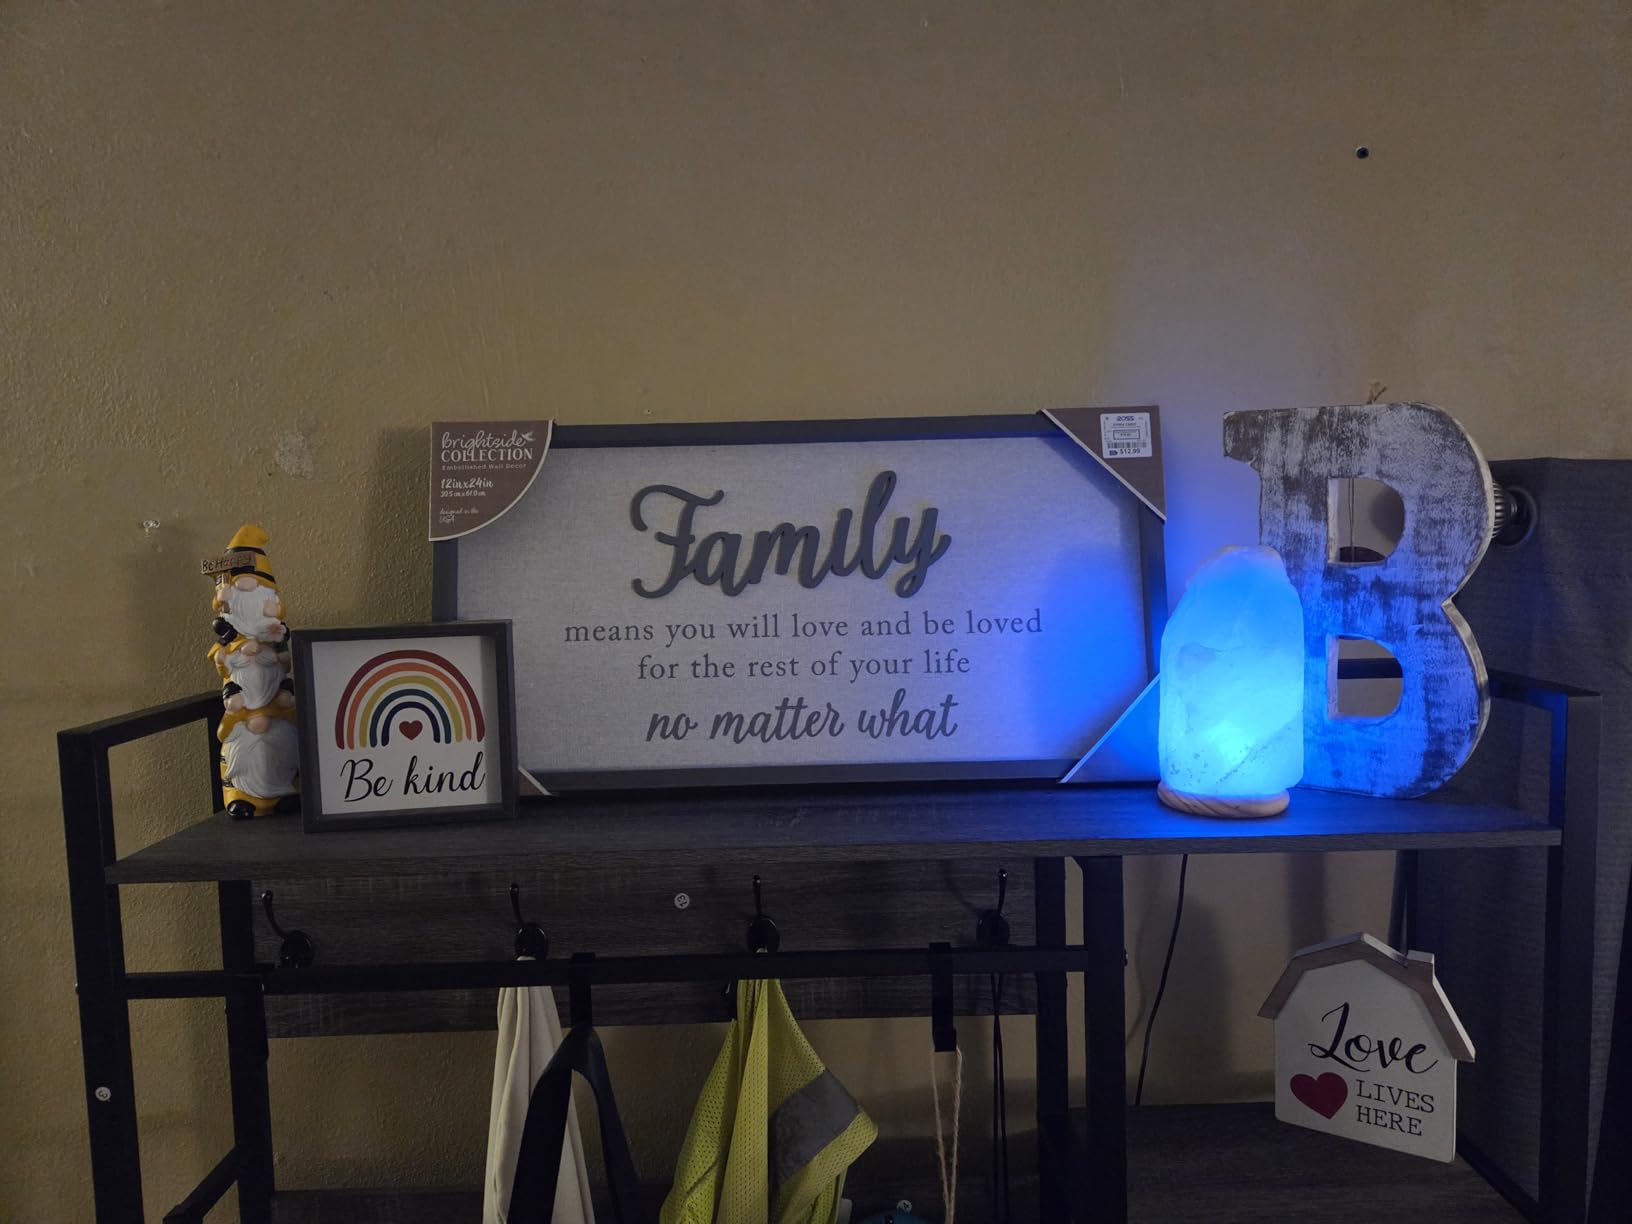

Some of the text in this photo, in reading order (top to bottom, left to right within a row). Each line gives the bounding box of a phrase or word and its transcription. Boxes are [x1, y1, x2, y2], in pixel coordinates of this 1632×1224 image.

[441, 448, 533, 463] COLLECTION
[442, 430, 526, 457] brightside
[630, 470, 952, 599] Family
[1223, 402, 1493, 799] B
[564, 608, 1043, 648] means you will love and be loved
[637, 648, 971, 684] for the rest of your life
[645, 688, 959, 744] no matter what
[340, 751, 488, 802] Be kind
[1307, 1001, 1439, 1074] Love
[1355, 1079, 1435, 1113] LIVES
[1355, 1104, 1423, 1137] HERE
